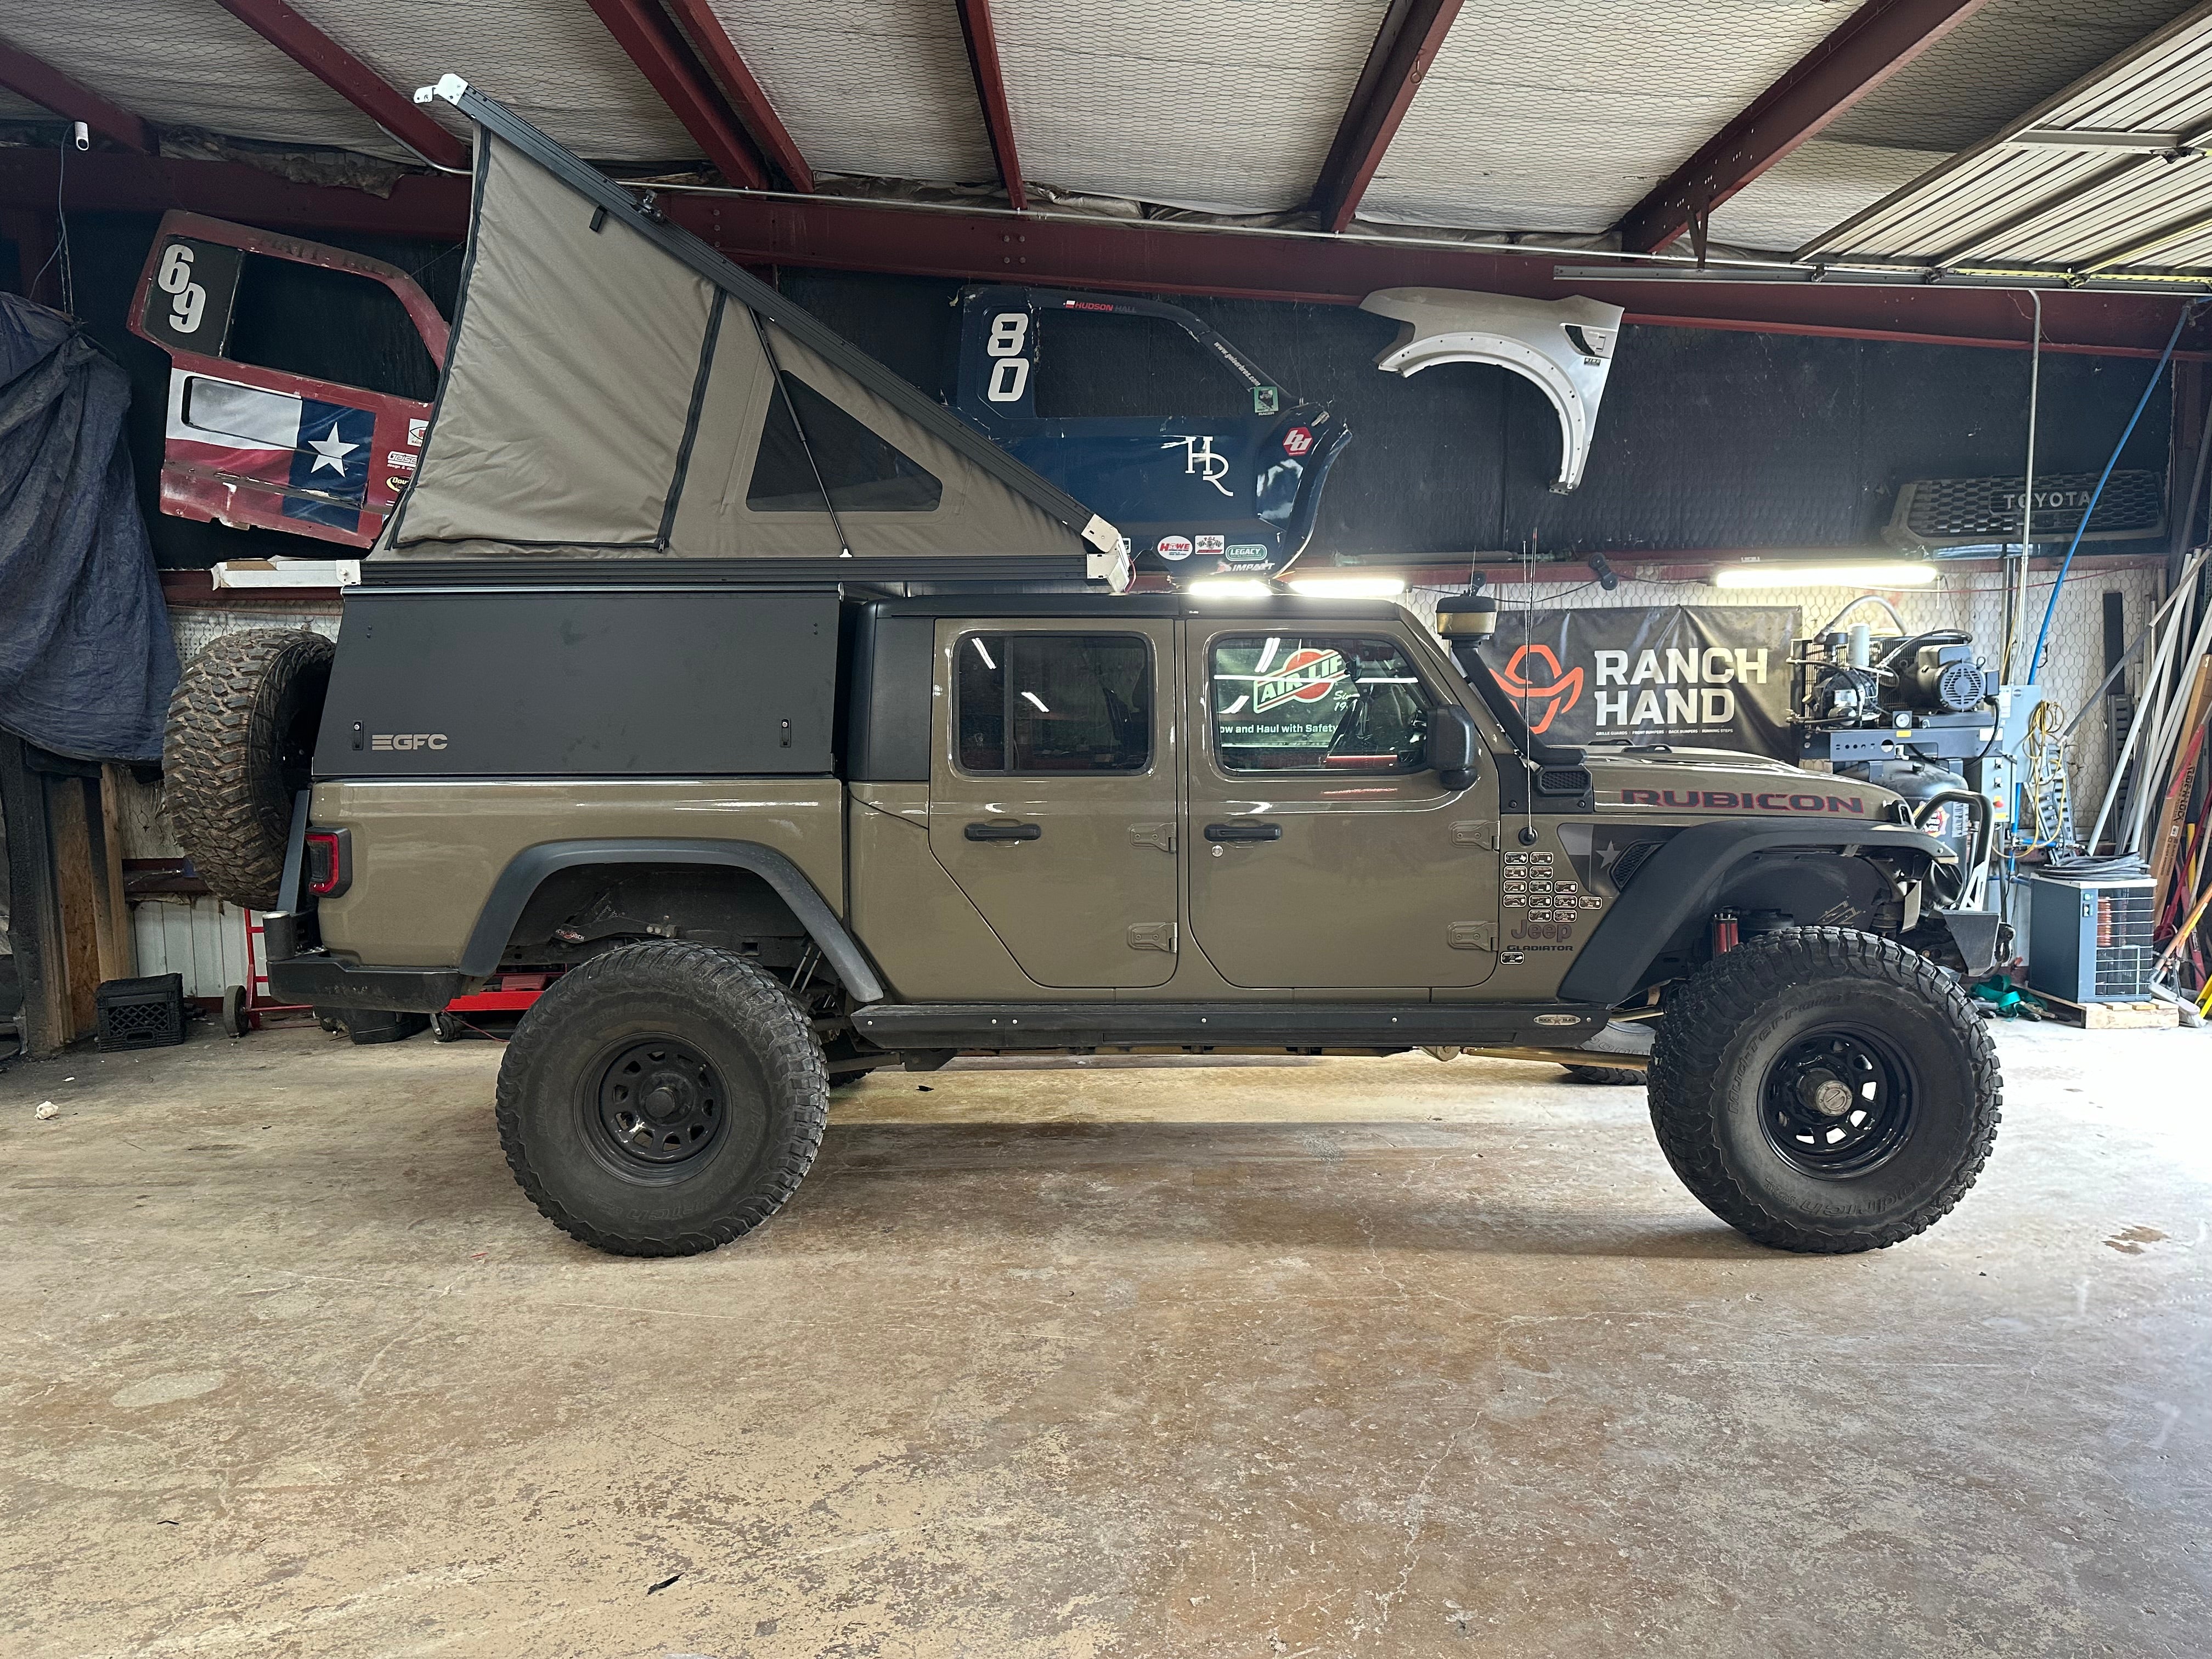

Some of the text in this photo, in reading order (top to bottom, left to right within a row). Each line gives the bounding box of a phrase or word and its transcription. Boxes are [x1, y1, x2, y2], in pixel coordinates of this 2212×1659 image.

[1075, 302, 1137, 313] HUDSON HALL
[988, 313, 1029, 402] 80
[389, 453, 417, 464] Geise
[1261, 653, 1342, 703] AIR LIF
[1594, 647, 1768, 686] RANCH
[1595, 687, 1735, 725] HAND
[1235, 724, 1254, 733] and
[1257, 724, 1279, 733] Haul
[1282, 724, 1303, 733] with
[1305, 724, 1338, 735] Safety
[1621, 789, 1864, 813] RUBICON
[1511, 919, 1572, 943] Jeep
